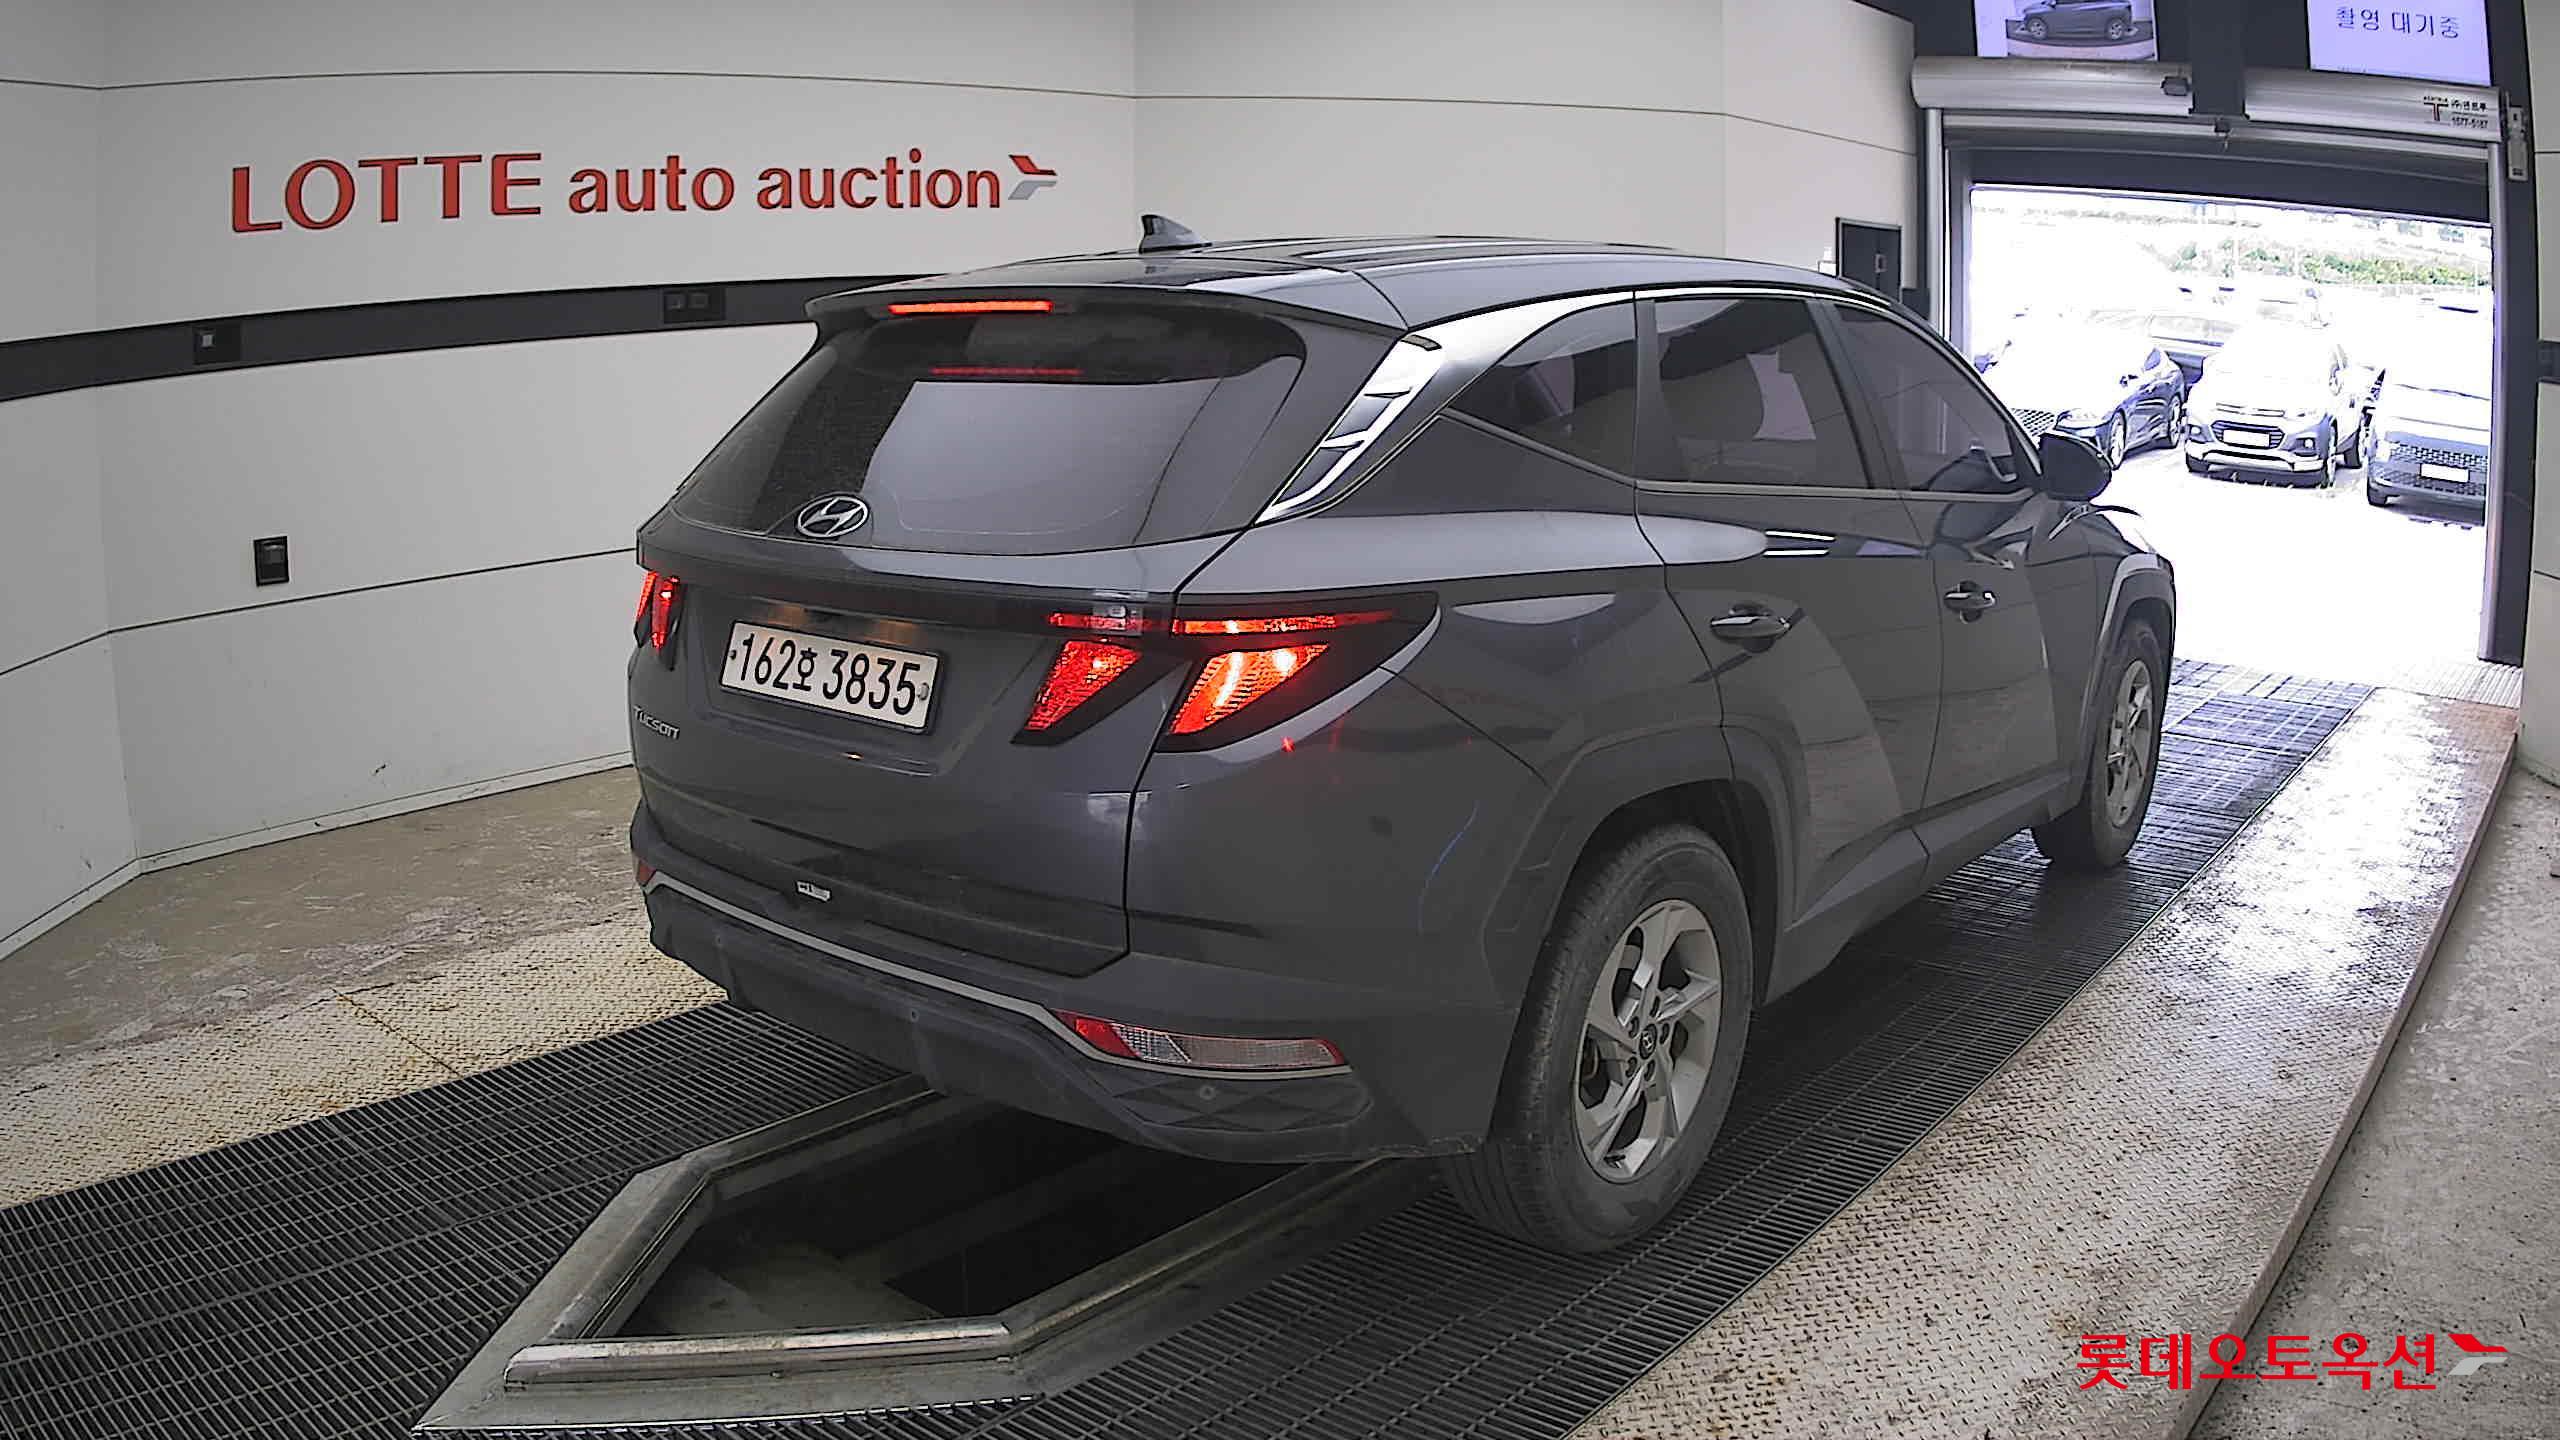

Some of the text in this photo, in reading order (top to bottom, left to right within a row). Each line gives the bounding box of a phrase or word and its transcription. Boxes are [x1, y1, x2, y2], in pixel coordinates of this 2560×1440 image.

[2391, 11, 2459, 39] 대기중
[232, 148, 1001, 233] LOTTE auto auction
[740, 632, 922, 716] 162호 3835
